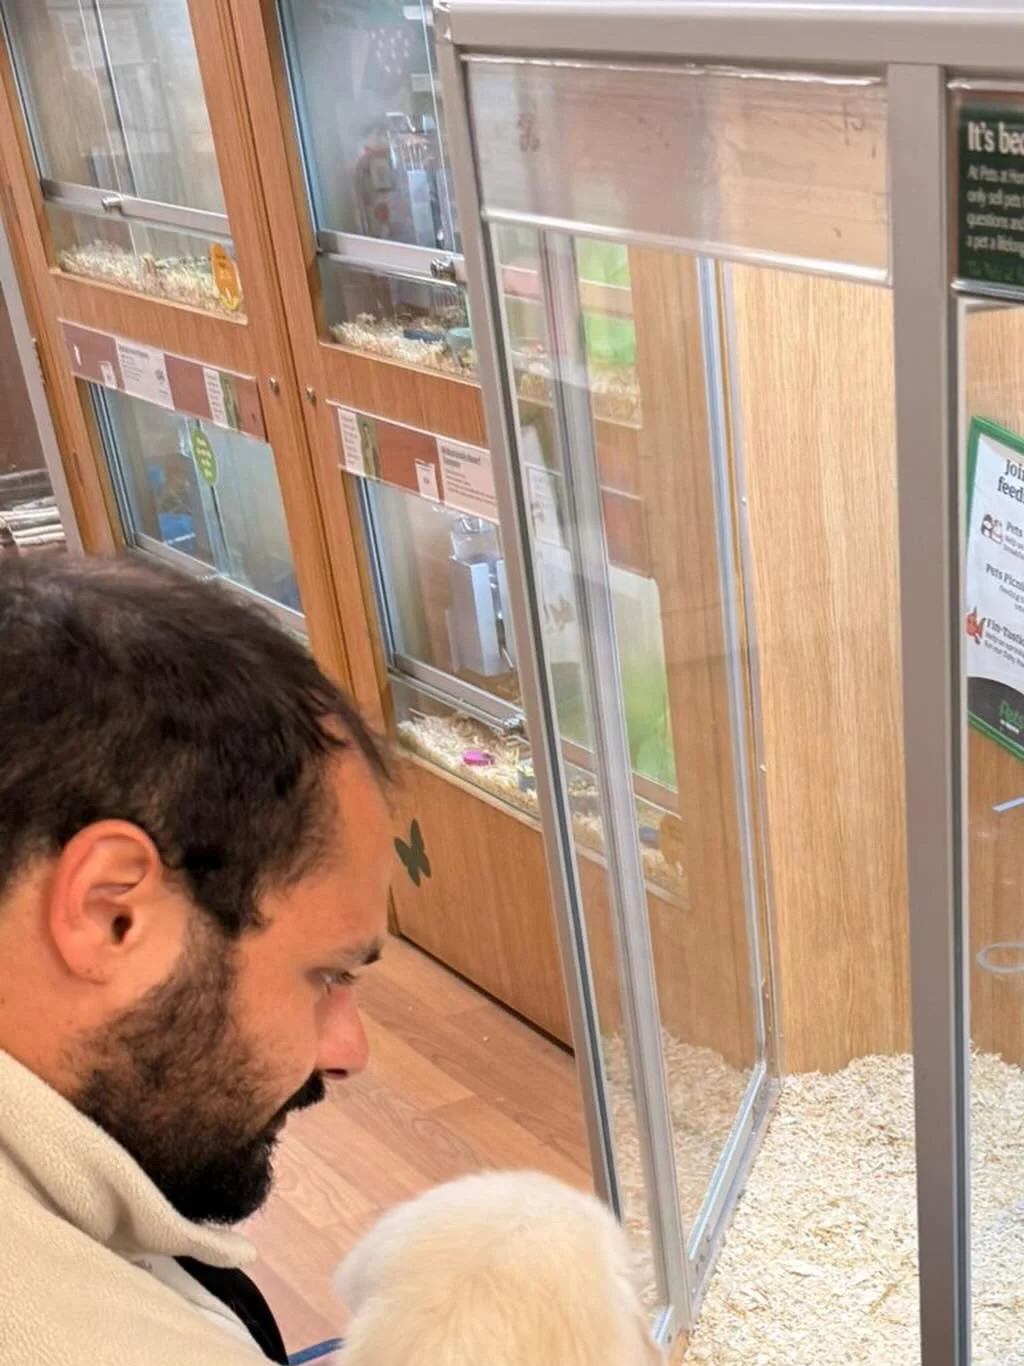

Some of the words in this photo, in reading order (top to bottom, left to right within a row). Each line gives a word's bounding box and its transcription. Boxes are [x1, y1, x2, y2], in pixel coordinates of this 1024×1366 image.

[967, 120, 995, 152] It's
[1006, 521, 1023, 538] Pets
[985, 564, 1003, 578] Pets
